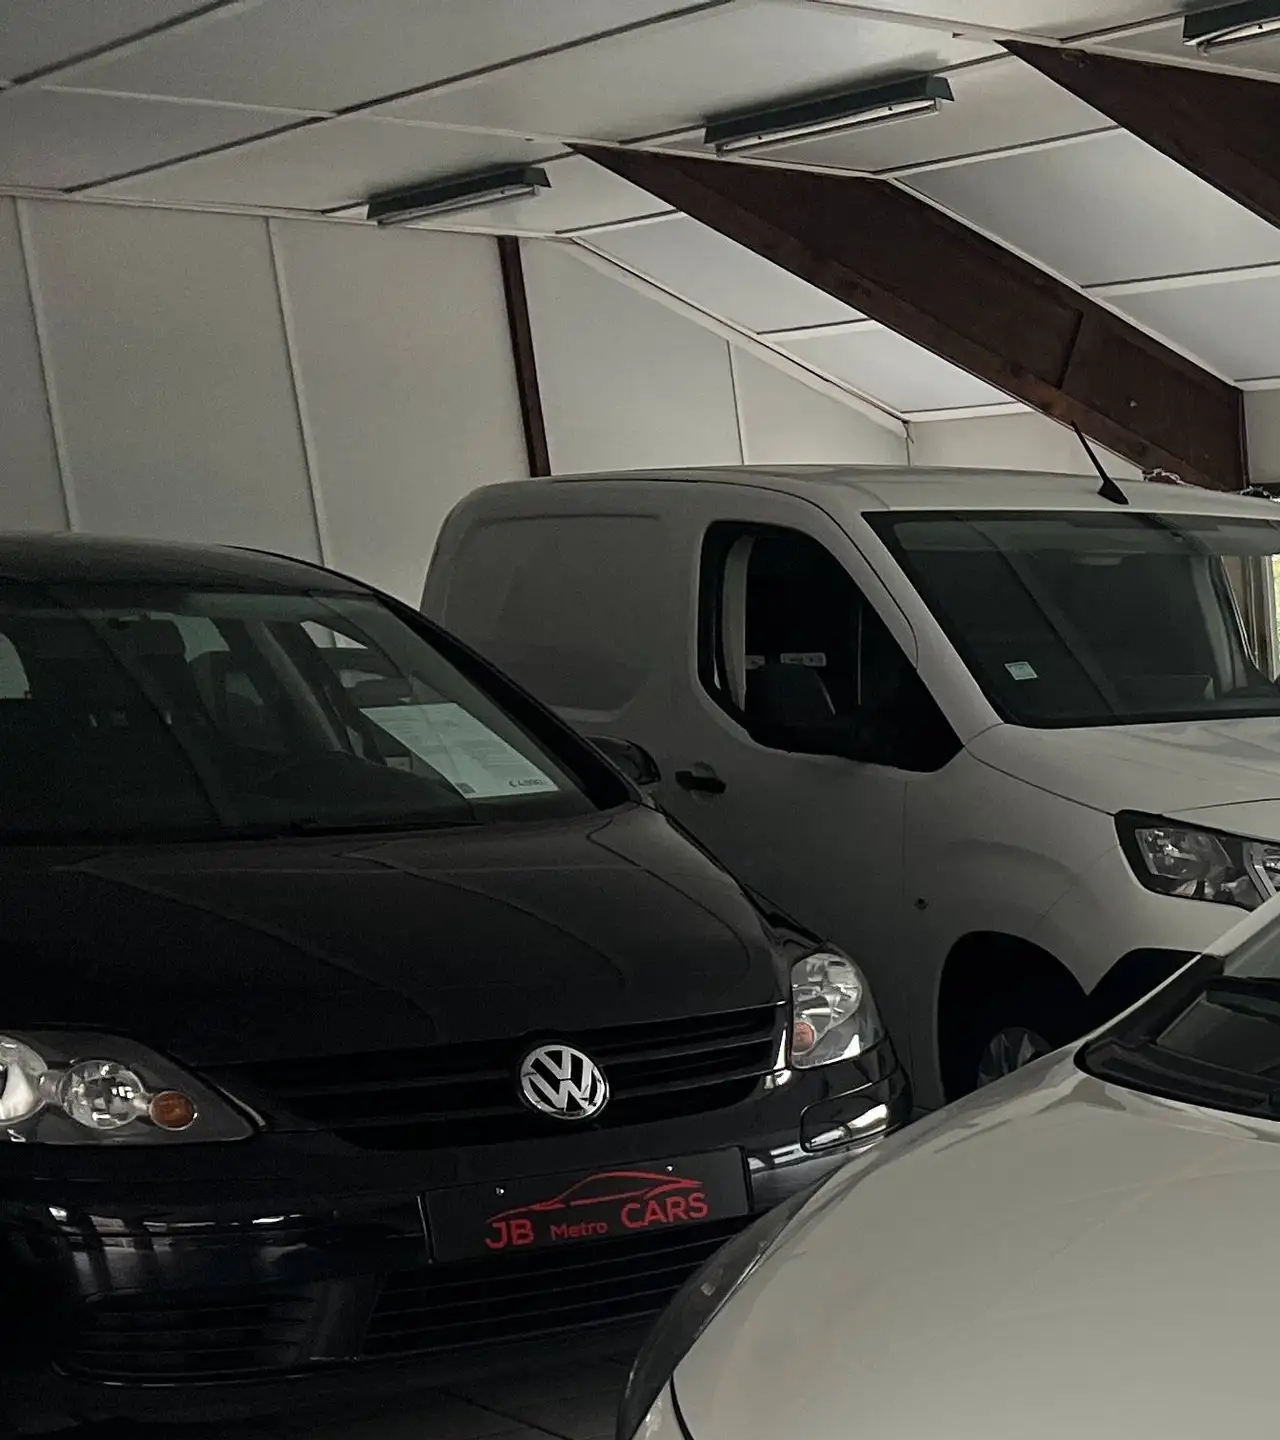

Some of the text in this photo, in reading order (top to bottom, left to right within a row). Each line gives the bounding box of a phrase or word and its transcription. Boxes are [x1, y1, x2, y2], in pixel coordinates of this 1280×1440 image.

[485, 1192, 708, 1248] JB Metro CARS
